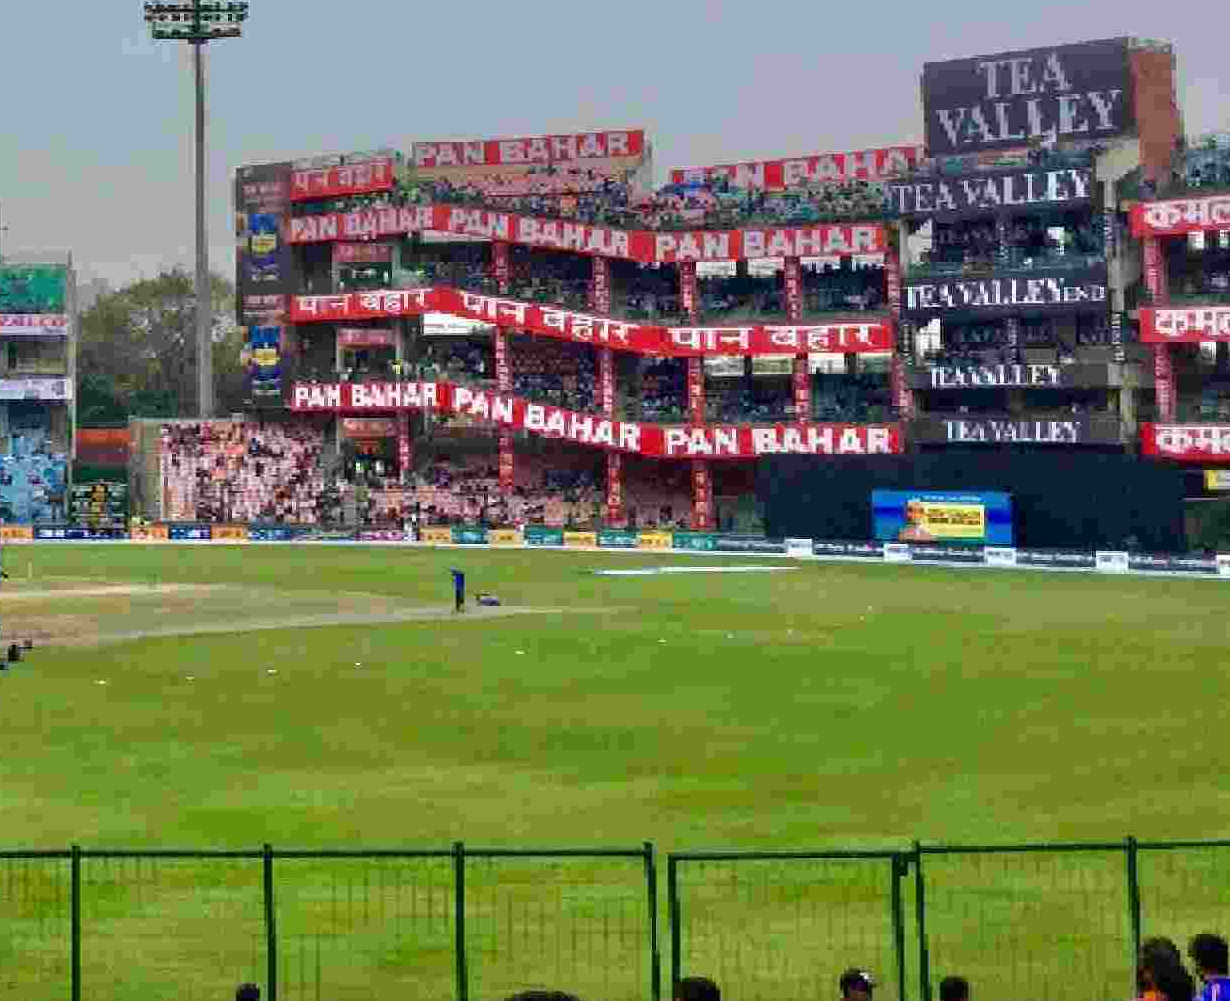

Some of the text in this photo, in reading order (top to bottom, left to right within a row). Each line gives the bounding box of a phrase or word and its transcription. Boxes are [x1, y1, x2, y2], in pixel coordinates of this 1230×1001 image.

[974, 52, 1072, 97] TEA
[934, 89, 1122, 148] VALLEY
[418, 132, 627, 166] PAN BAHAR
[887, 168, 1090, 213] TEA VALLEY
[291, 203, 432, 242] PAN BAHAR
[449, 205, 629, 256] PAN BAHAR
[656, 226, 876, 261] PAN BAHAR
[907, 281, 957, 311] TEA
[956, 275, 1062, 306] VALLEY
[460, 293, 642, 346] पान बहार
[665, 326, 754, 352] पान
[762, 323, 882, 352] बहार
[295, 382, 437, 407] PAN BAHAR
[454, 385, 641, 454] PAN BAHAR
[945, 420, 1081, 444] TEA VALLEY
[665, 428, 895, 455] PAN BAHAR
